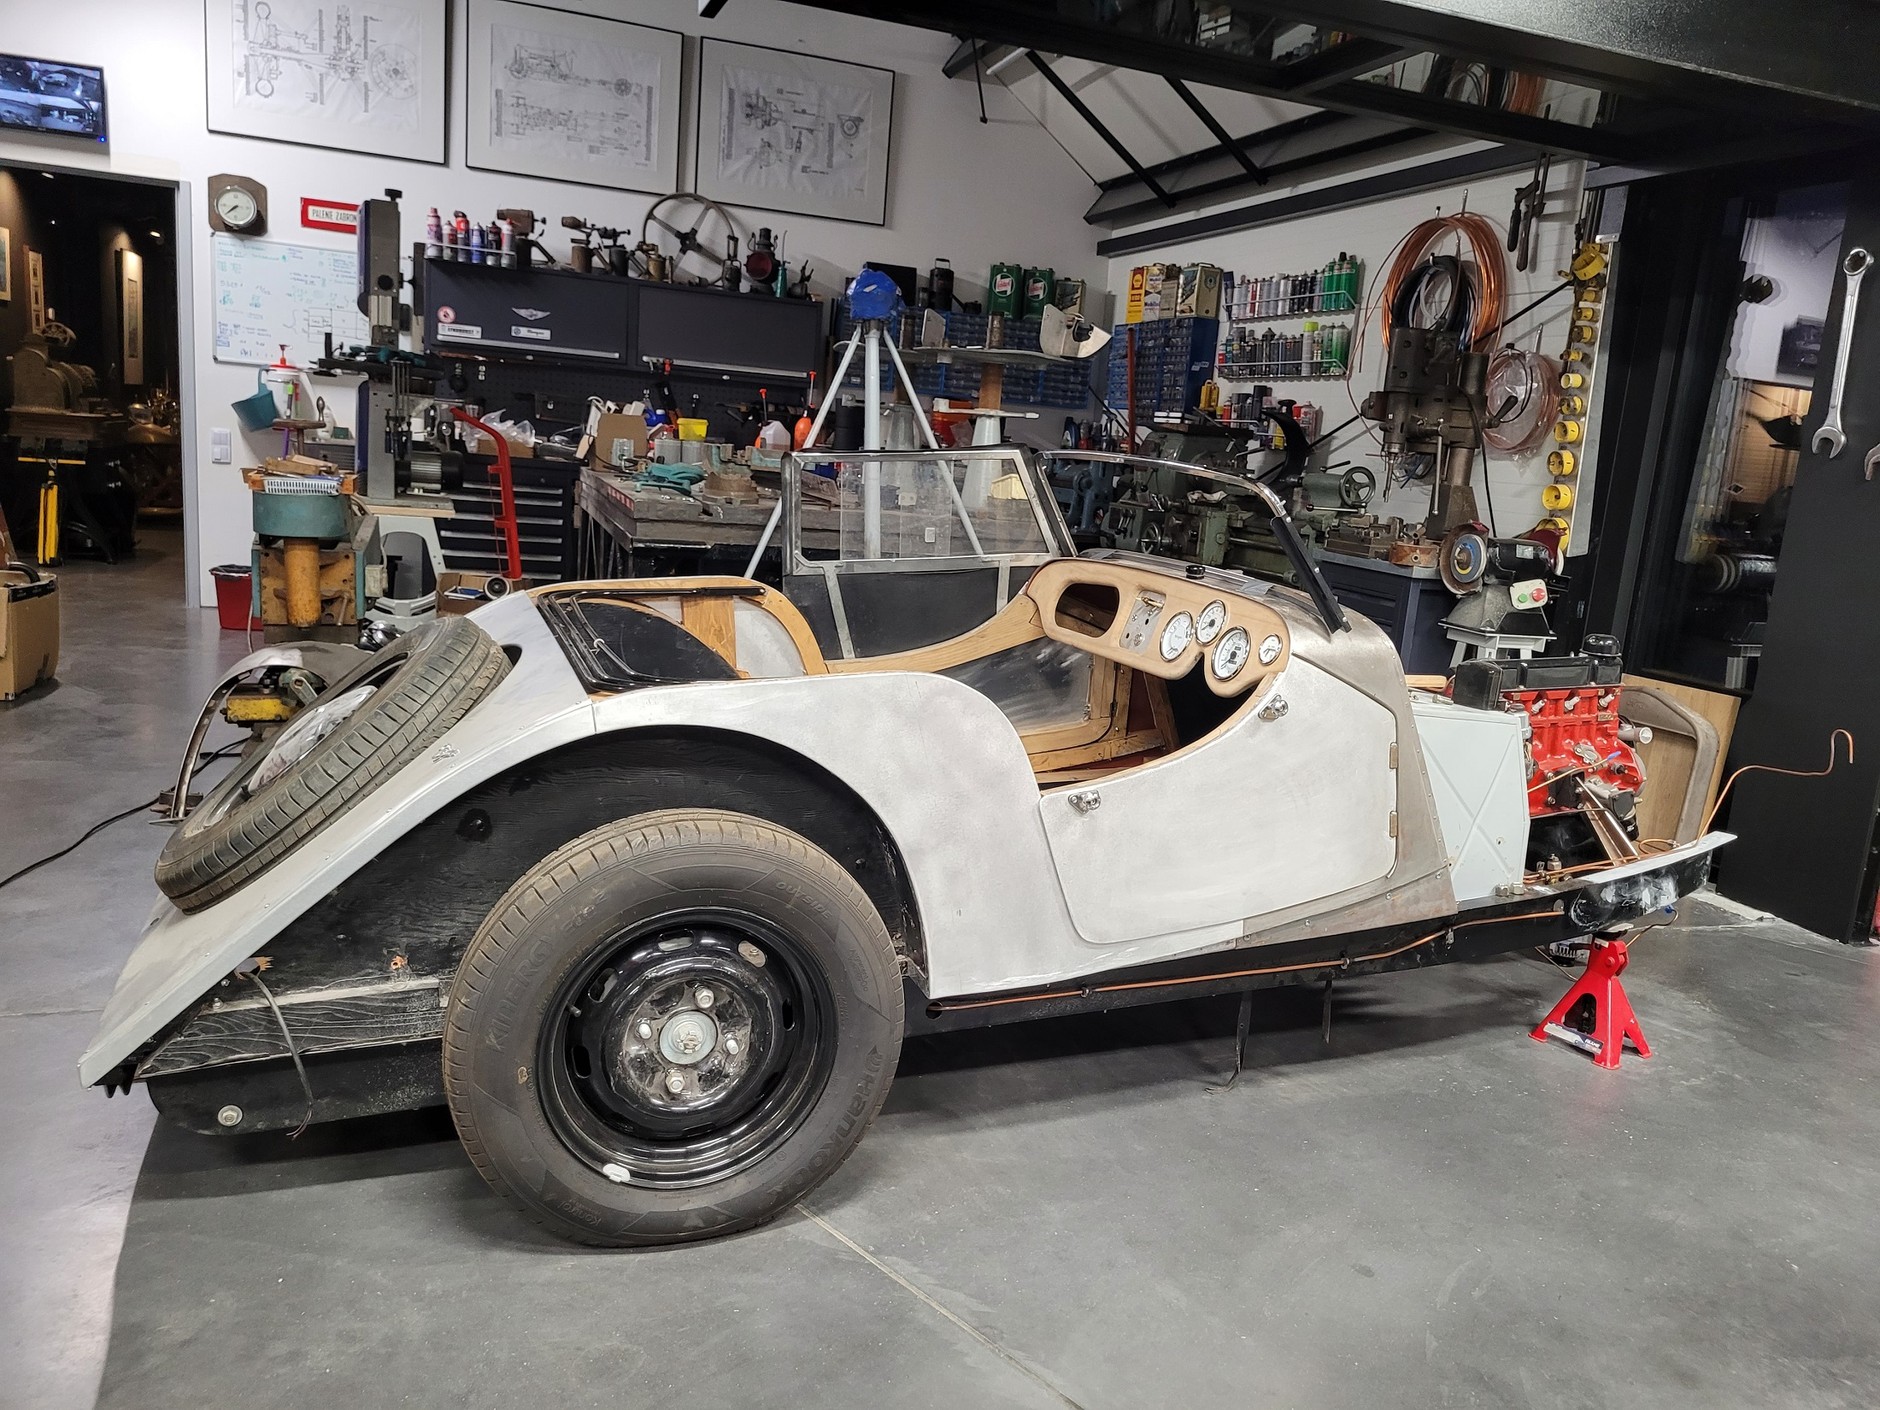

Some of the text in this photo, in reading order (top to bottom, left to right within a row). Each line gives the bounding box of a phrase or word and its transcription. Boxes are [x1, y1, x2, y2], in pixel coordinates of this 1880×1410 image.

[312, 209, 333, 220] PALENIE
[776, 881, 832, 919] OUTSIDE
[767, 1074, 875, 1196] Hankook
